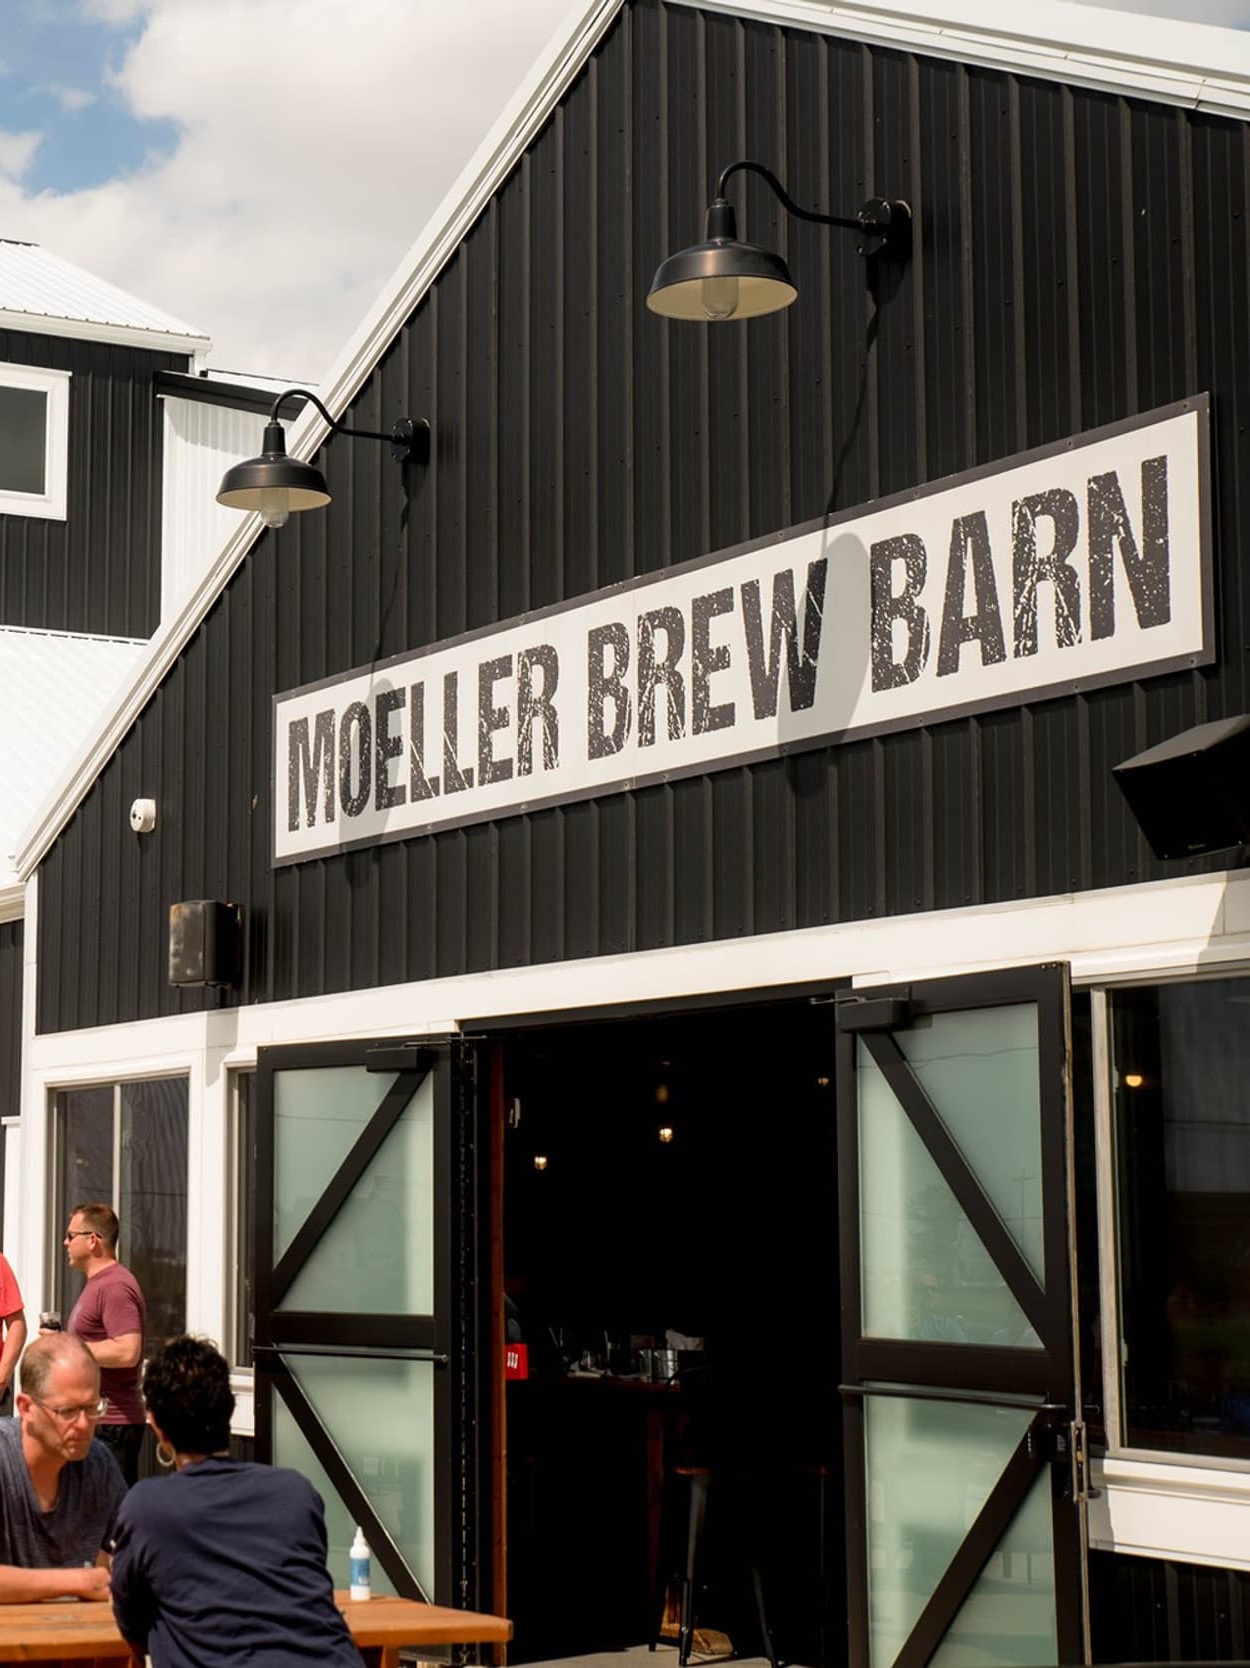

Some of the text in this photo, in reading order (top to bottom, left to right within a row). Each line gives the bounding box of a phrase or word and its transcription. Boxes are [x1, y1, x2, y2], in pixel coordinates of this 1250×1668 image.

[287, 455, 1172, 832] MOELLER BREW BARN
